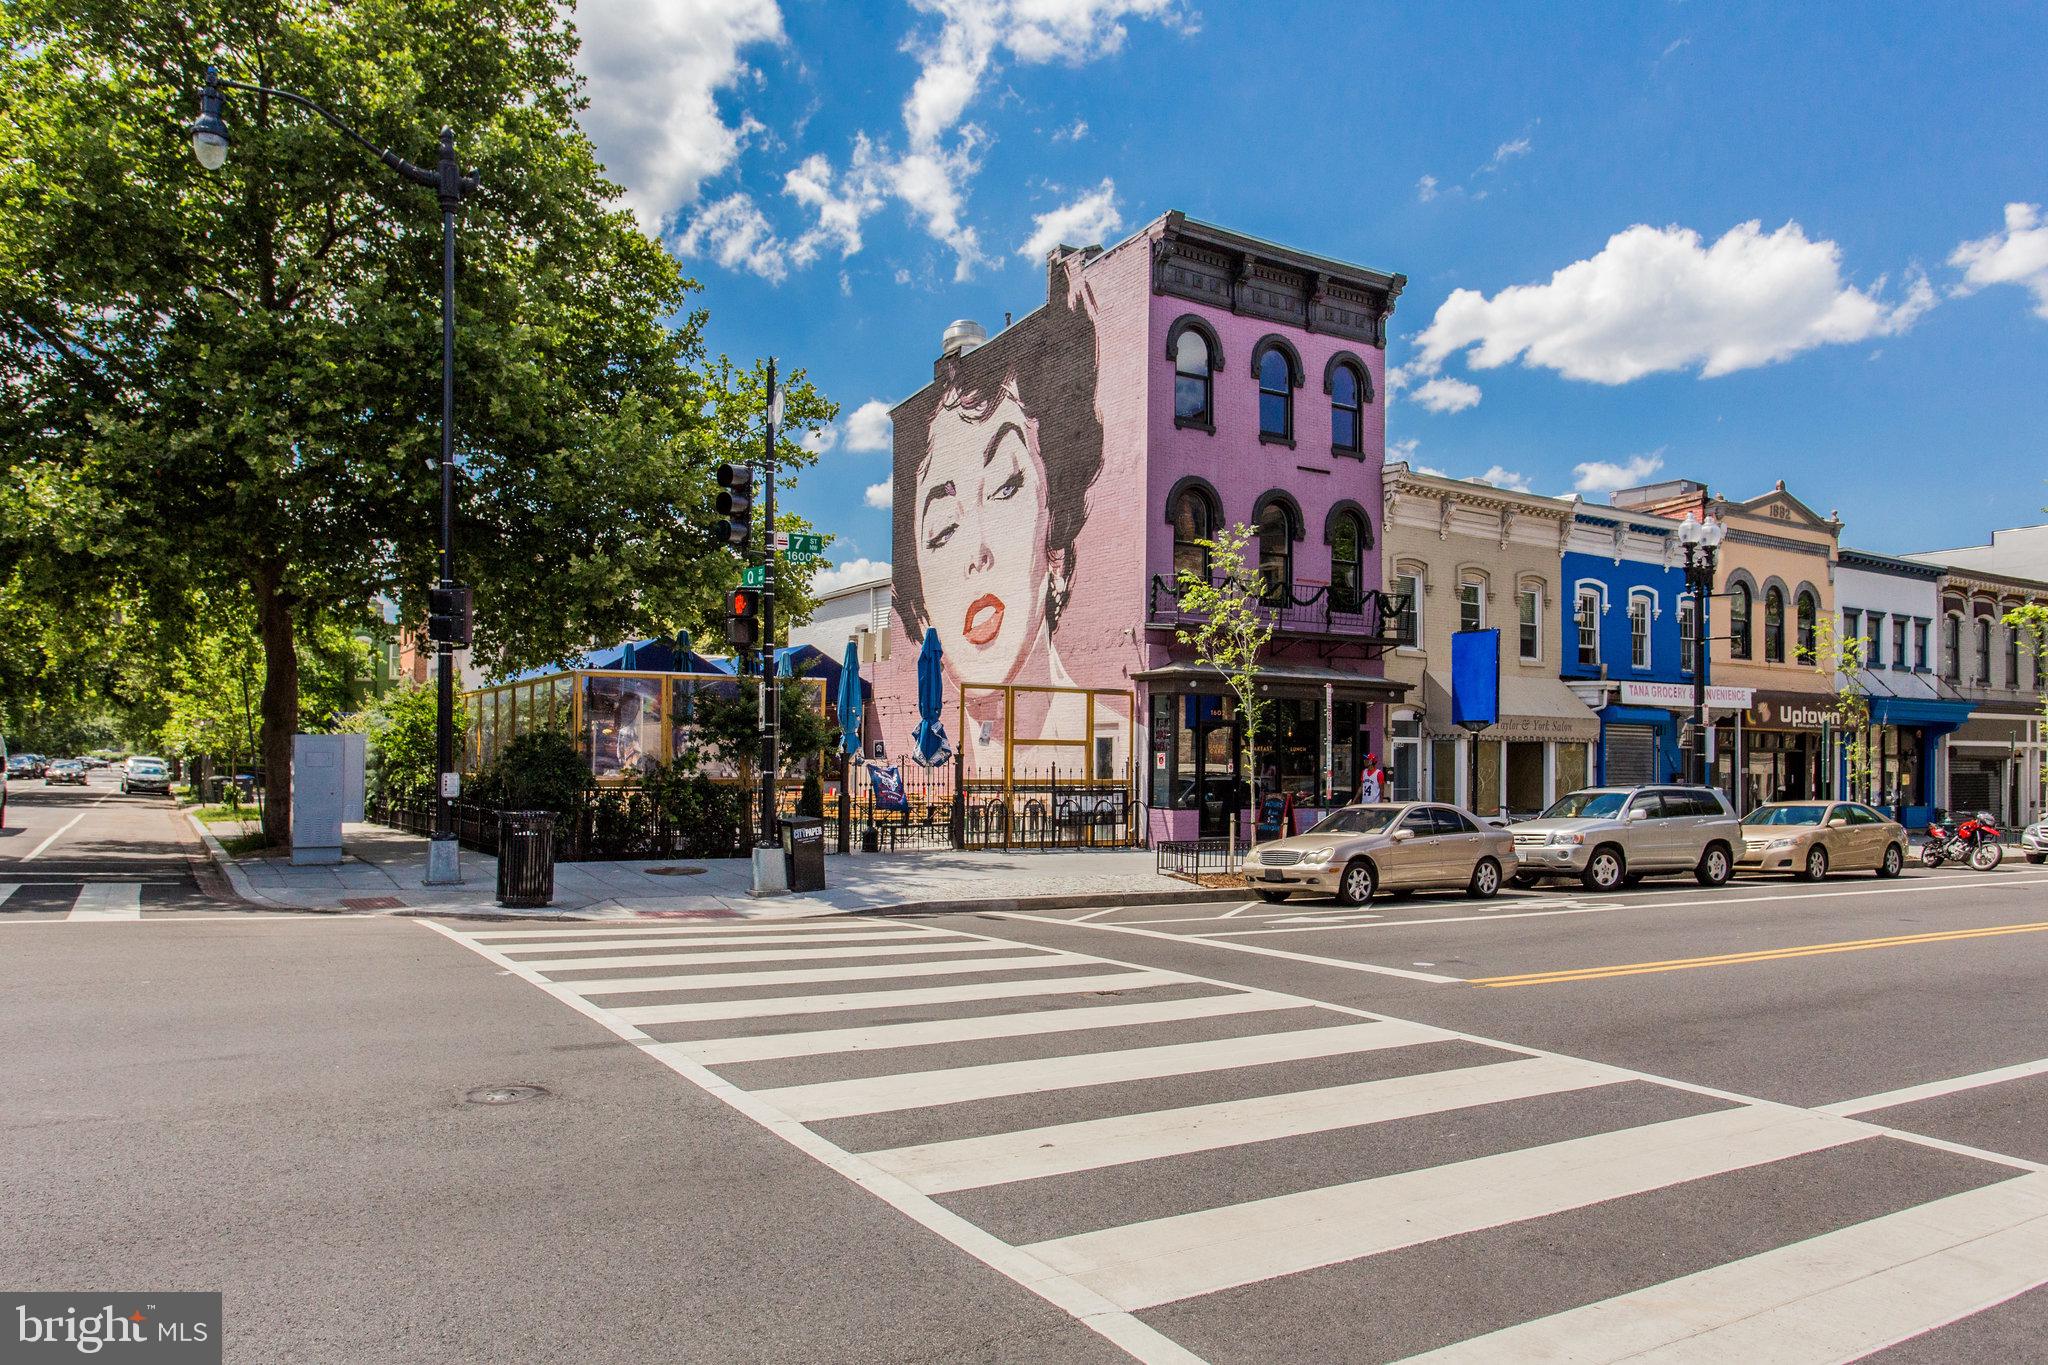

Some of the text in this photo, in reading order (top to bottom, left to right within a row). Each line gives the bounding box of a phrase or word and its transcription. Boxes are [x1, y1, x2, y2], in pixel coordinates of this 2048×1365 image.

[793, 536, 804, 550] 7
[787, 550, 812, 562] 1600
[747, 570, 754, 584] Q
[1628, 684, 1650, 697] TANA
[1652, 686, 1686, 699] GROCERY
[1706, 689, 1746, 701] NVENIENCE
[1780, 706, 1840, 727] Uptown
[1496, 718, 1573, 732] Taylor & York Salon
